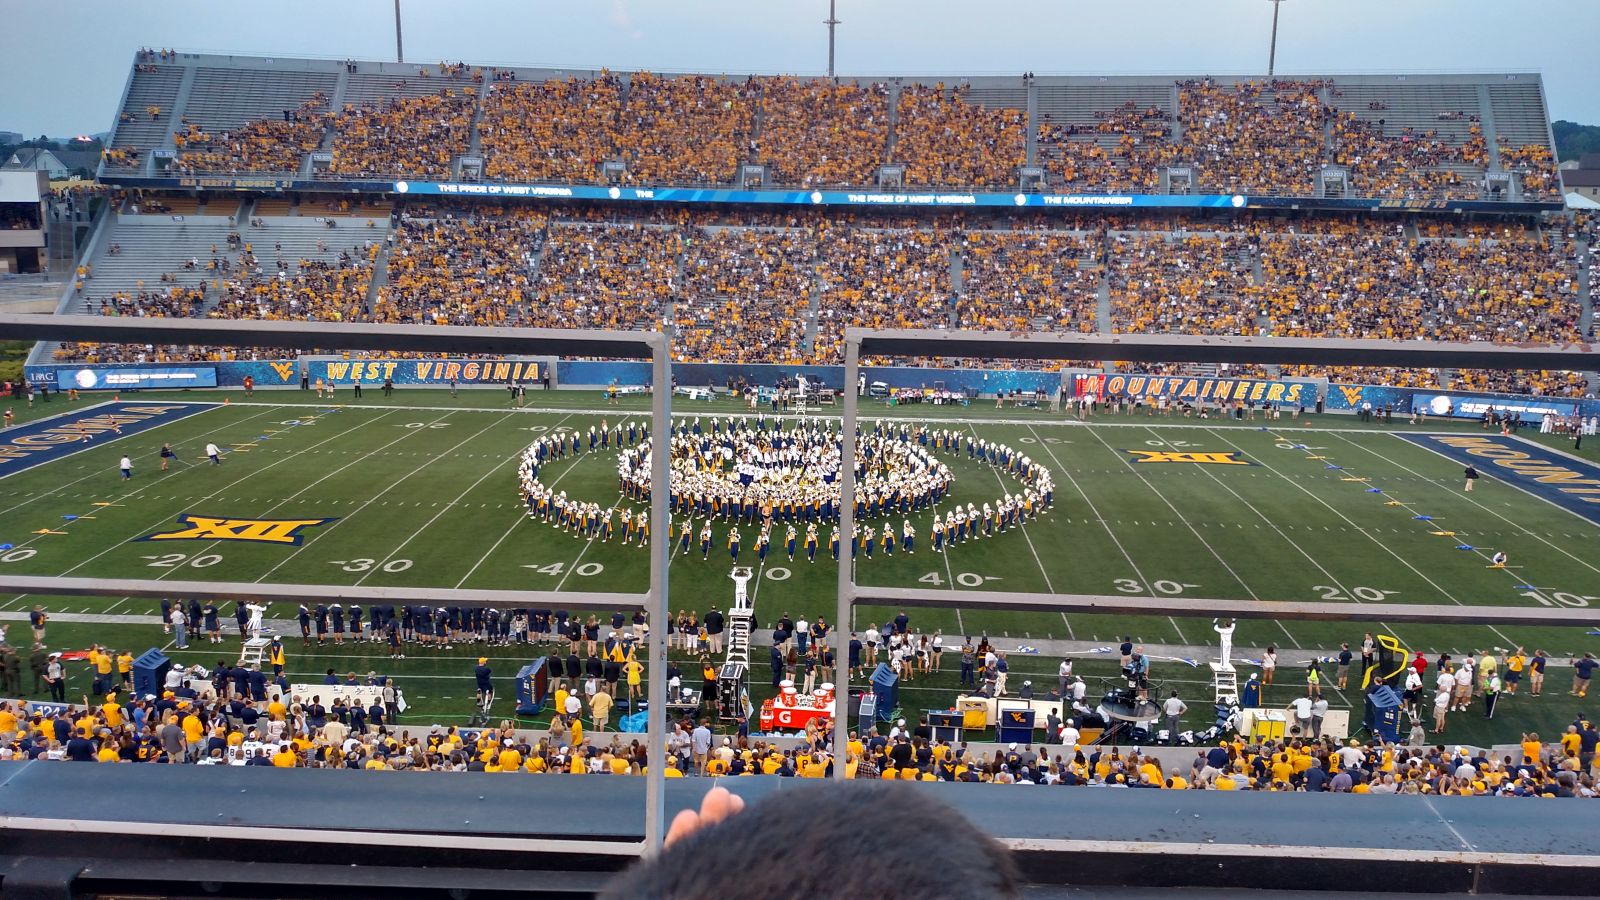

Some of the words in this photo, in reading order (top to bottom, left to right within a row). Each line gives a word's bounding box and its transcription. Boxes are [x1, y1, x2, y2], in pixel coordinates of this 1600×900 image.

[458, 185, 487, 193] PRIDE
[531, 188, 573, 196] VIRGINIA
[636, 190, 654, 198] THE
[31, 372, 55, 381] IMG
[327, 361, 398, 380] WEST
[416, 361, 540, 380] VIRGINIA
[1085, 375, 1303, 402] MOUNTAINEERS
[149, 515, 325, 542] XII
[147, 553, 223, 568] 20
[342, 558, 414, 573] 30
[536, 562, 604, 576] 40
[918, 571, 984, 587] 40
[1113, 578, 1184, 595] 30
[1312, 585, 1385, 601] 20
[1520, 591, 1589, 607] 10
[37, 705, 60, 718] 124
[779, 711, 792, 724] G
